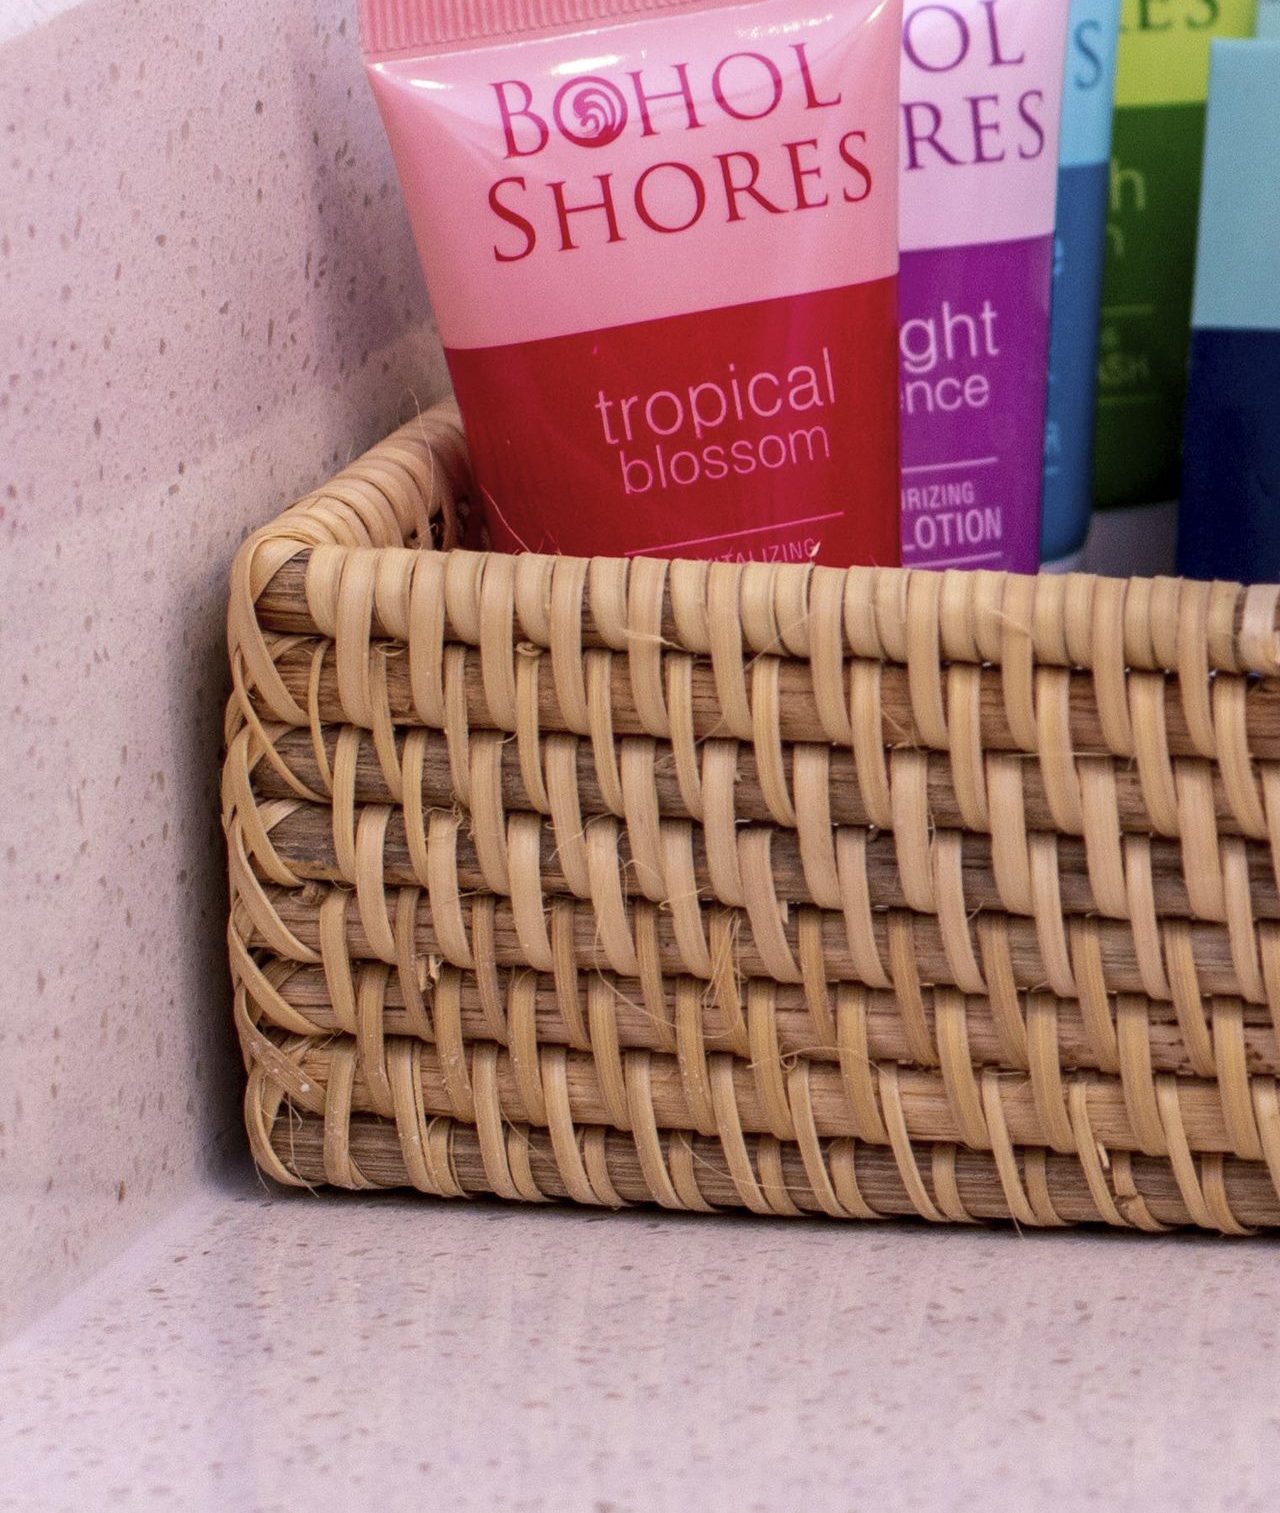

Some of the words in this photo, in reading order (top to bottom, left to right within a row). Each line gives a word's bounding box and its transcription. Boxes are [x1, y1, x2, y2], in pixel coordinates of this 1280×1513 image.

[490, 43, 841, 159] BOHOL
[488, 131, 872, 262] SHORES
[595, 347, 834, 444] tropical
[620, 426, 830, 494] blossom
